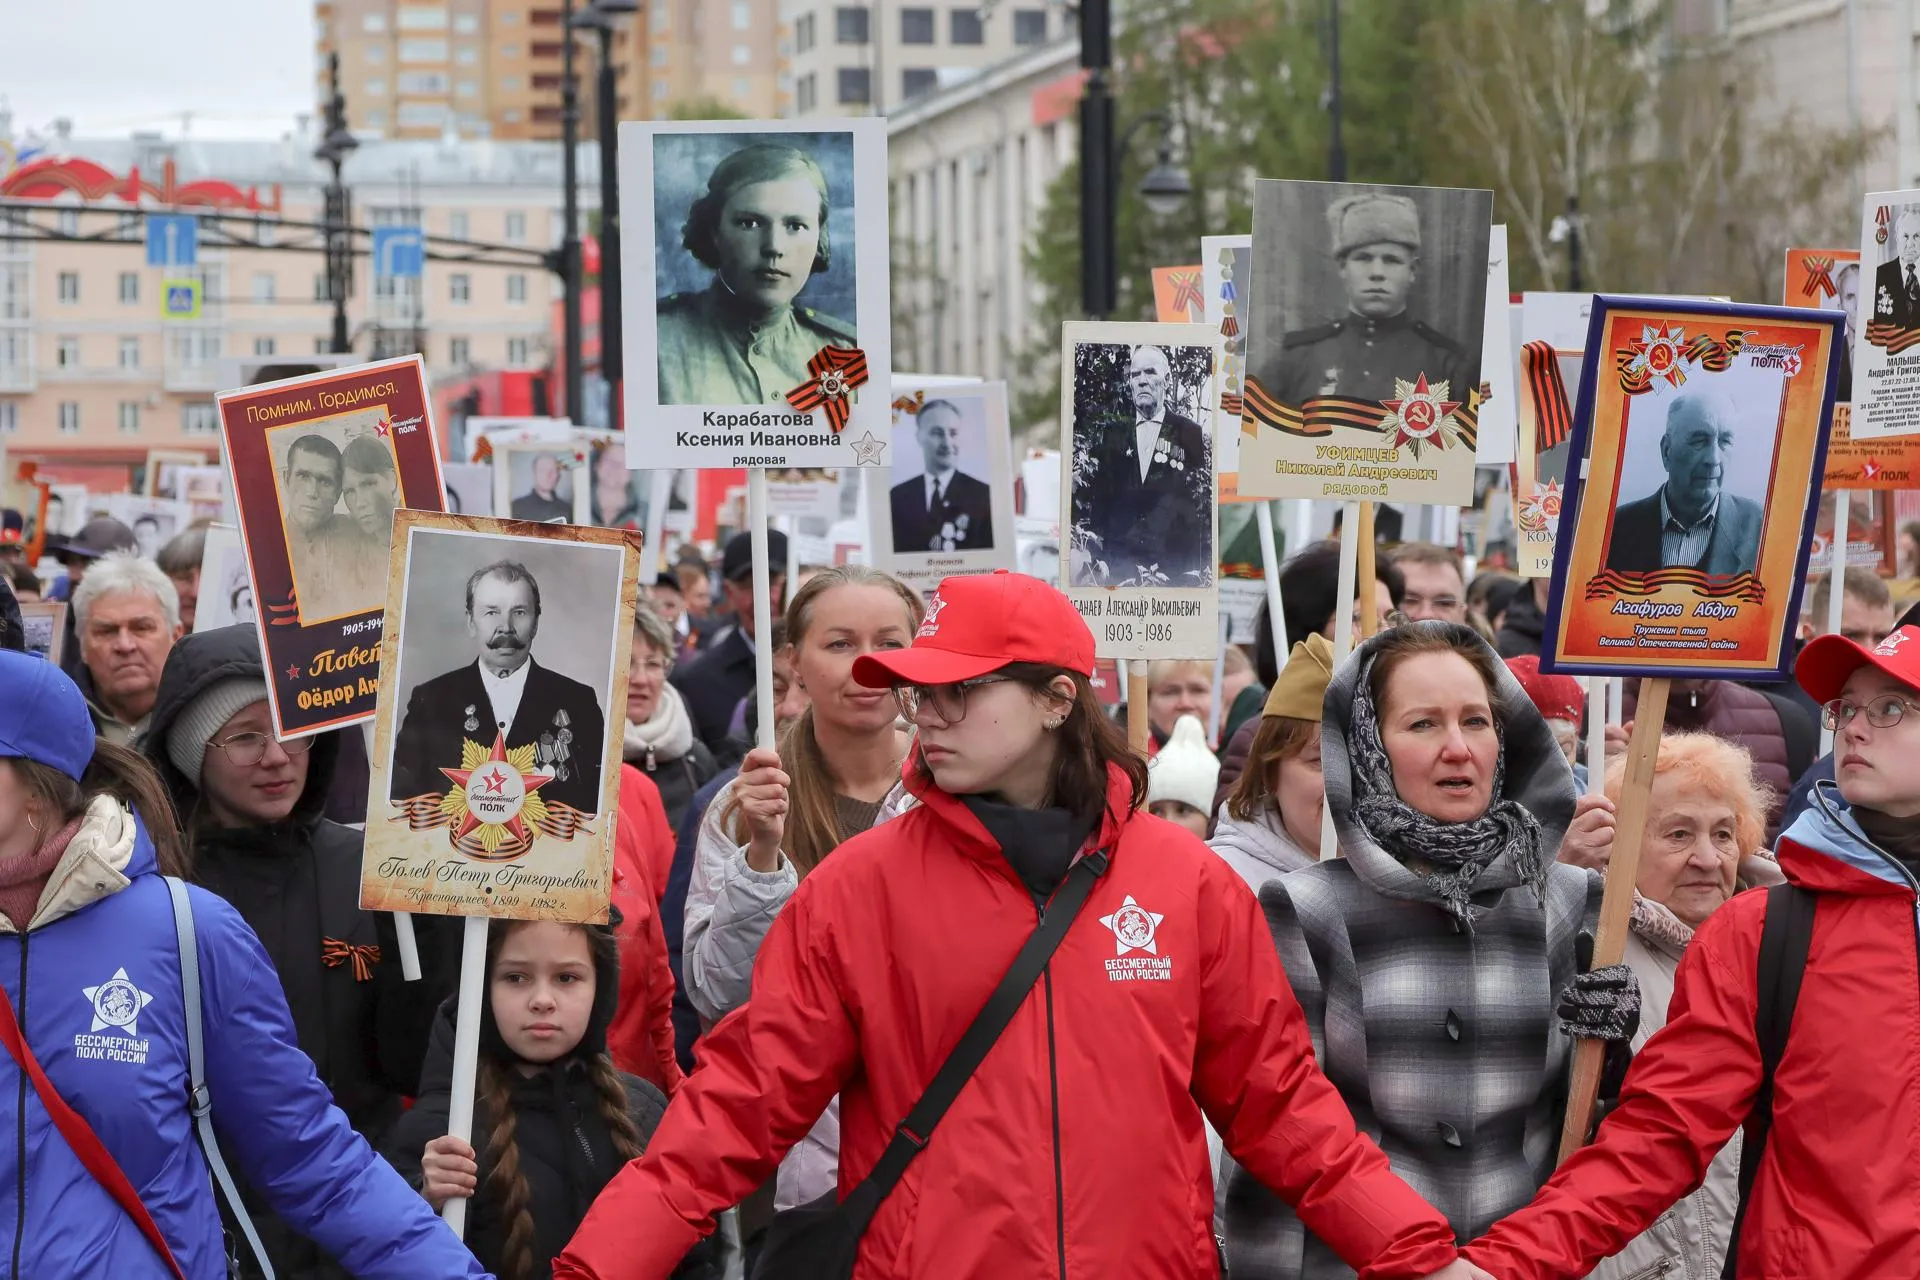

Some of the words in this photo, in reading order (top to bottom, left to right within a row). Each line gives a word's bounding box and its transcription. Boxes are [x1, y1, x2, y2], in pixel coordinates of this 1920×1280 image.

[1751, 356, 1785, 369] ПОЛК
[1868, 368, 1894, 379] Андрей
[247, 398, 316, 423] Помним.
[319, 382, 399, 409] Гордимся.
[703, 411, 814, 430] Карабатова
[398, 424, 417, 435] ПОЛК
[676, 431, 744, 447] Ксения
[750, 431, 841, 447] Ивановна
[733, 456, 786, 467] рядовая
[1316, 445, 1400, 463] УФИМЦЕВ
[1276, 459, 1345, 476] Николай
[1348, 464, 1438, 480] Андреевич
[1881, 470, 1910, 481] ПОЛК
[1323, 483, 1389, 496] рядовой
[1071, 600, 1102, 617] БАНАЕВ
[1611, 600, 1683, 618] Агафуров
[1694, 602, 1738, 620] Абдул
[1105, 623, 1133, 642] 1903
[1145, 623, 1172, 642] 1986
[1634, 624, 1677, 637] Труженик
[1681, 627, 1708, 636] тыла
[1599, 636, 1636, 647] Великой
[1639, 637, 1708, 649] Отечественной
[1711, 640, 1738, 649] войны
[297, 685, 355, 710] Фёдор
[480, 803, 506, 812] ПОЛК
[436, 860, 491, 890] Петр
[495, 864, 599, 894] Григорьевич
[404, 887, 490, 908] Красноармеец
[492, 895, 520, 907] 1899
[530, 897, 557, 909] 1982
[1104, 956, 1172, 971] БЕССМЕРТНЫЙ
[1109, 969, 1135, 981] ПОЛК
[1136, 968, 1171, 980] РОССИИ
[75, 1034, 149, 1053] БЕССМЕРТНЫЙ
[76, 1046, 104, 1060] ПОЛК
[106, 1048, 147, 1065] РОССИИ
